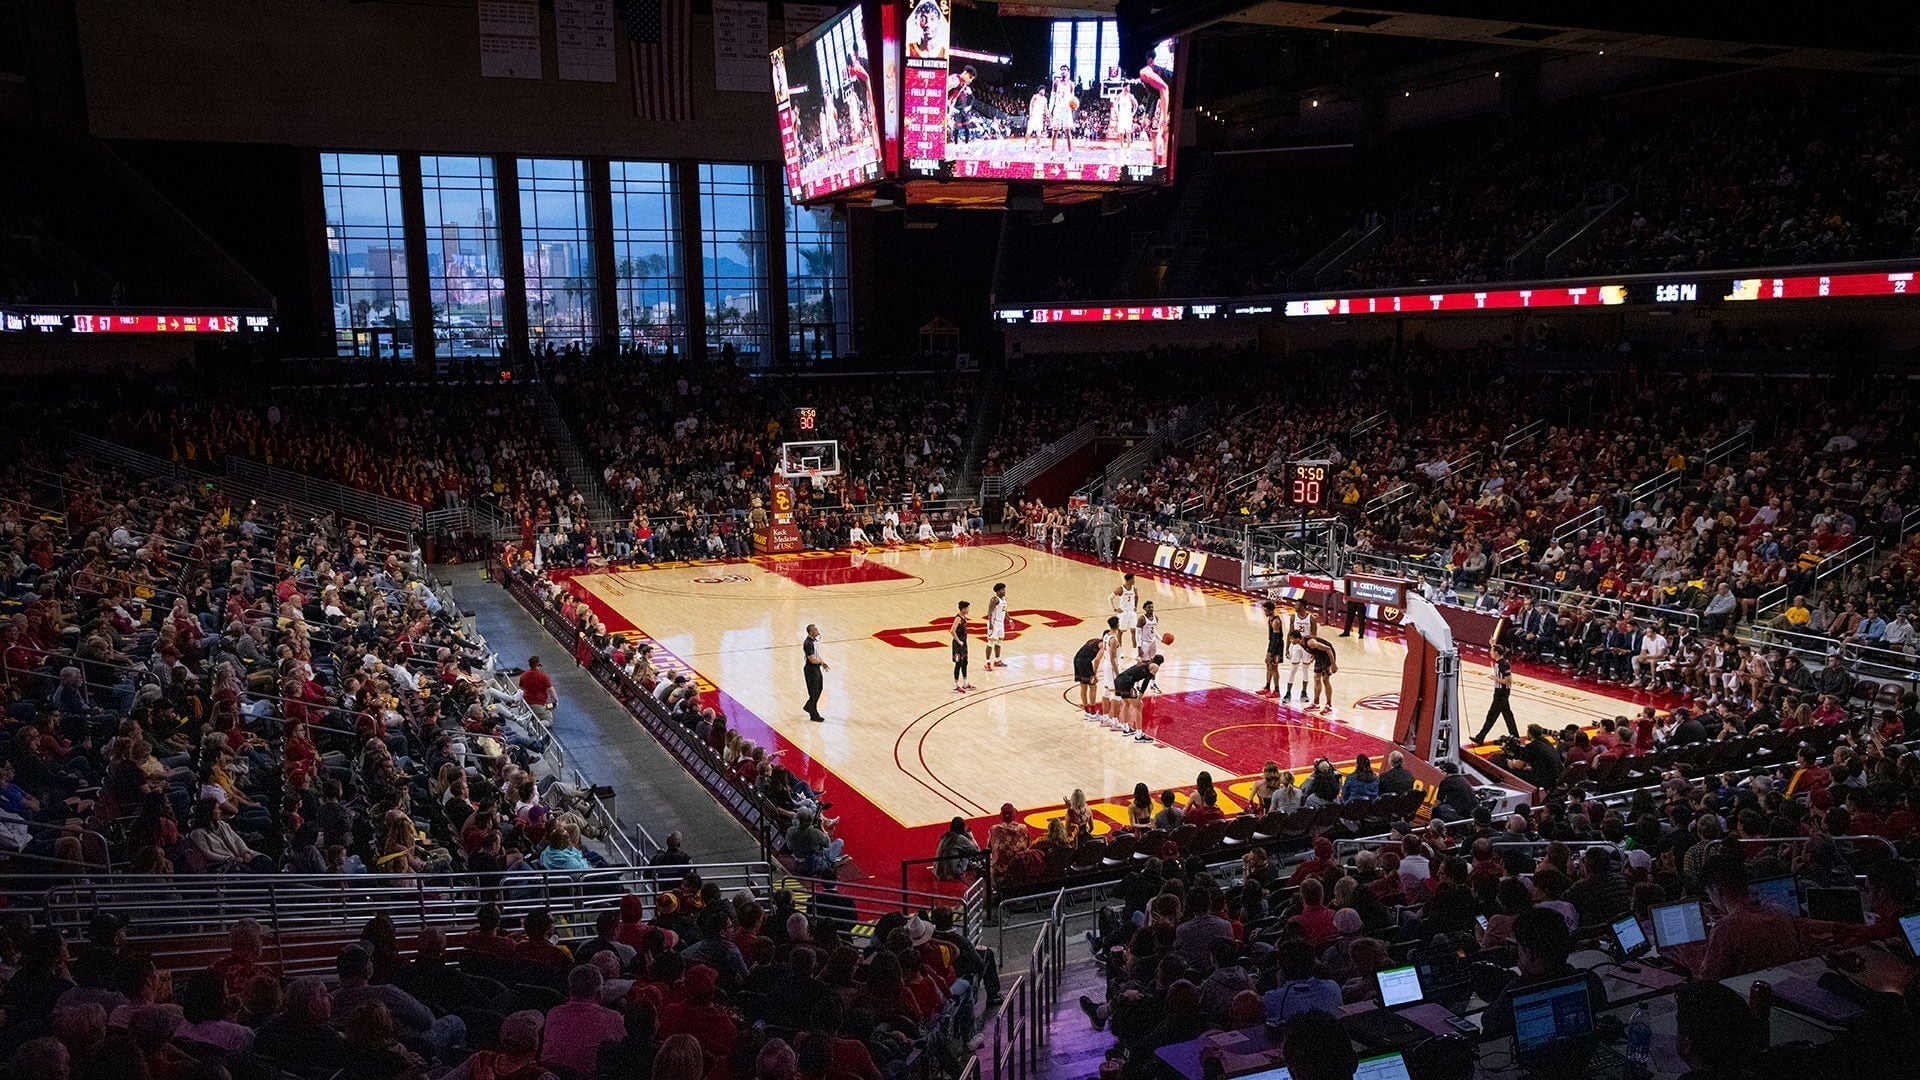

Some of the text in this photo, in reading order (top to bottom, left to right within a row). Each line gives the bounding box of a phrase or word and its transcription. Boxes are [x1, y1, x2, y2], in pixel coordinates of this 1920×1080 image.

[965, 161, 979, 176] 57
[1127, 166, 1153, 176] TROJANS
[1656, 284, 1697, 301] 5:05 PM
[30, 315, 63, 326] CARDINAL
[99, 317, 111, 331] 57
[246, 316, 269, 326] TROJANS
[800, 409, 816, 417] 9:50
[800, 417, 814, 429] 30
[1297, 466, 1324, 481] 9:50
[1293, 480, 1319, 503] 30
[776, 491, 790, 510] SC
[1373, 584, 1397, 595] Mortgage
